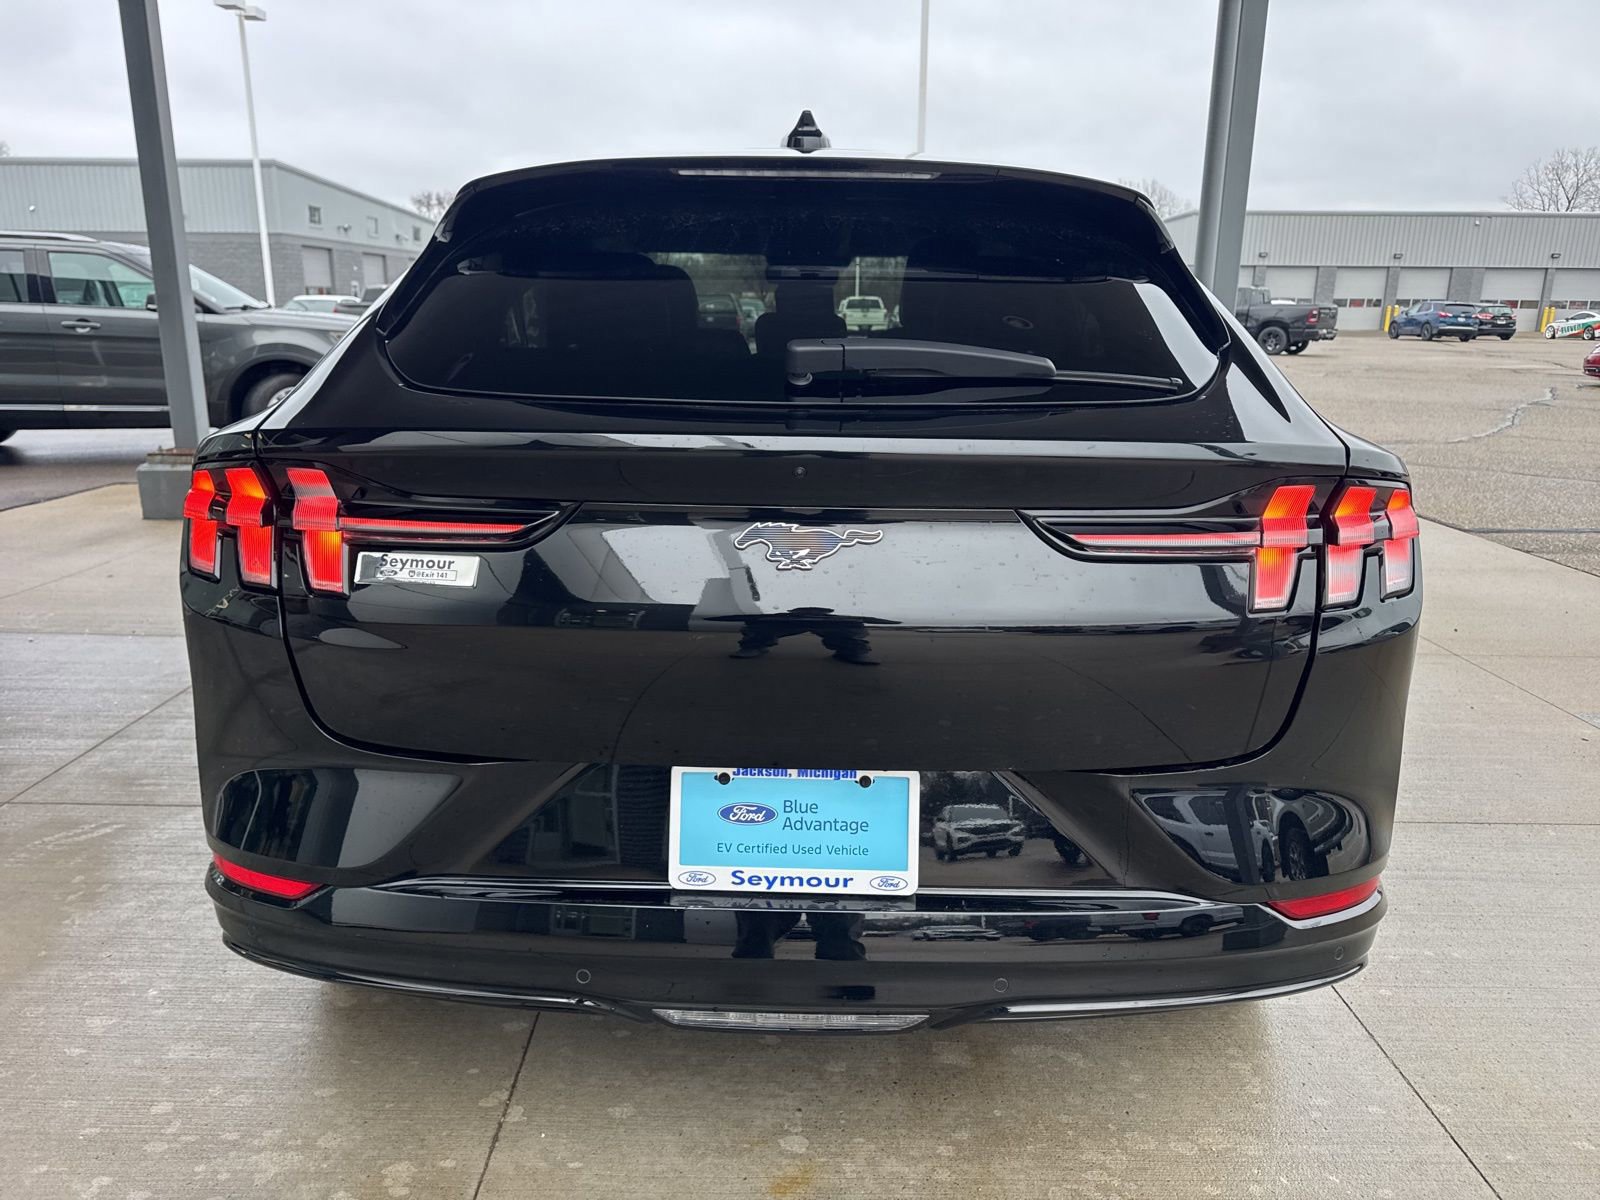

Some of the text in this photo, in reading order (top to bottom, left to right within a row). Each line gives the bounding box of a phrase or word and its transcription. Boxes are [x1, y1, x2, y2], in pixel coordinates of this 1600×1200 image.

[379, 553, 455, 571] Seymour
[729, 805, 766, 822] Ford
[783, 799, 818, 814] Blue
[782, 816, 869, 835] Advantage
[717, 842, 869, 856] EV Certified Used Vehicle
[685, 872, 709, 885] Ford
[731, 870, 854, 890] Seymour
[877, 877, 901, 889] Ford
